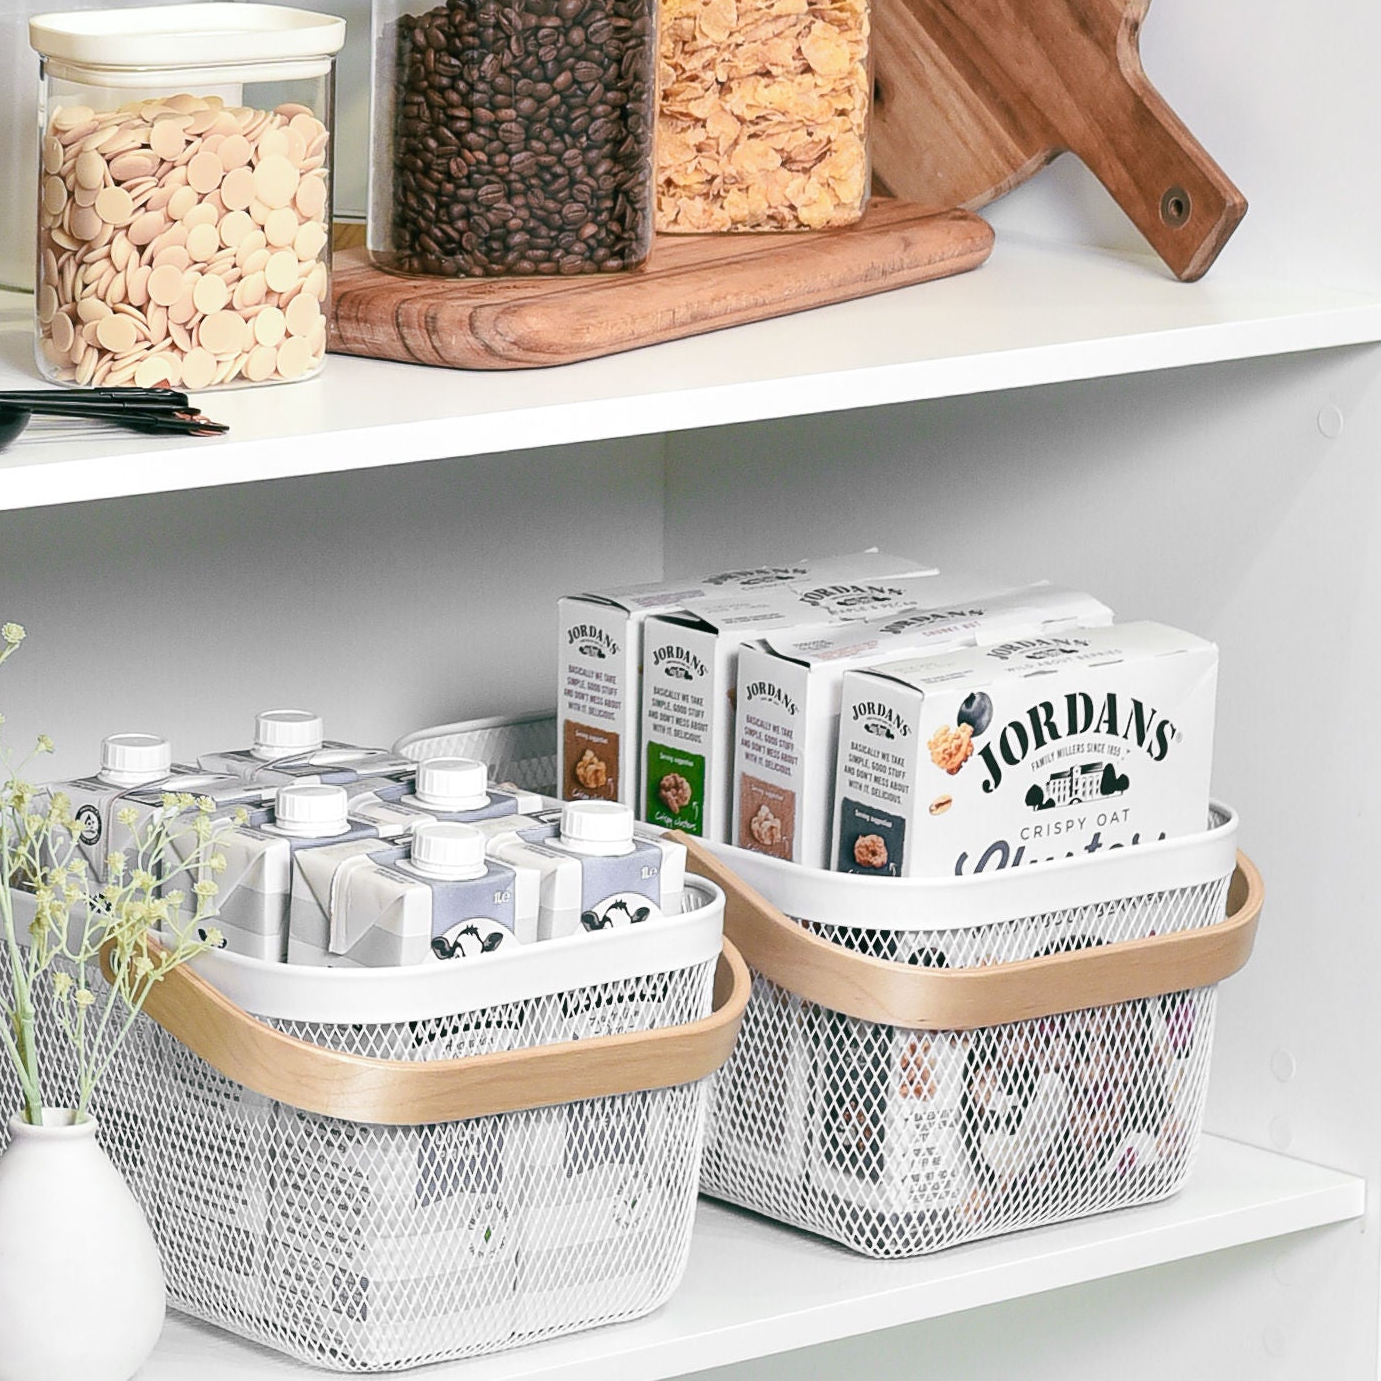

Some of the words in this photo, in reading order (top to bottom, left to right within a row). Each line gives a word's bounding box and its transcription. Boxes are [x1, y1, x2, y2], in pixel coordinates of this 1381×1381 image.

[568, 625, 617, 654] JORDANS
[987, 638, 1090, 661] JORDANS
[653, 646, 704, 676] JORDANS
[747, 682, 796, 715] JORDANS
[853, 702, 907, 736] JORDANS
[978, 692, 1177, 794] JORDANS
[1031, 751, 1055, 771] FAMILY
[1057, 743, 1085, 758] MILLERS
[1087, 743, 1105, 753] SINCE
[1107, 744, 1121, 757] 1855
[1020, 817, 1087, 841] CRISPY
[1096, 808, 1130, 827] OAT
